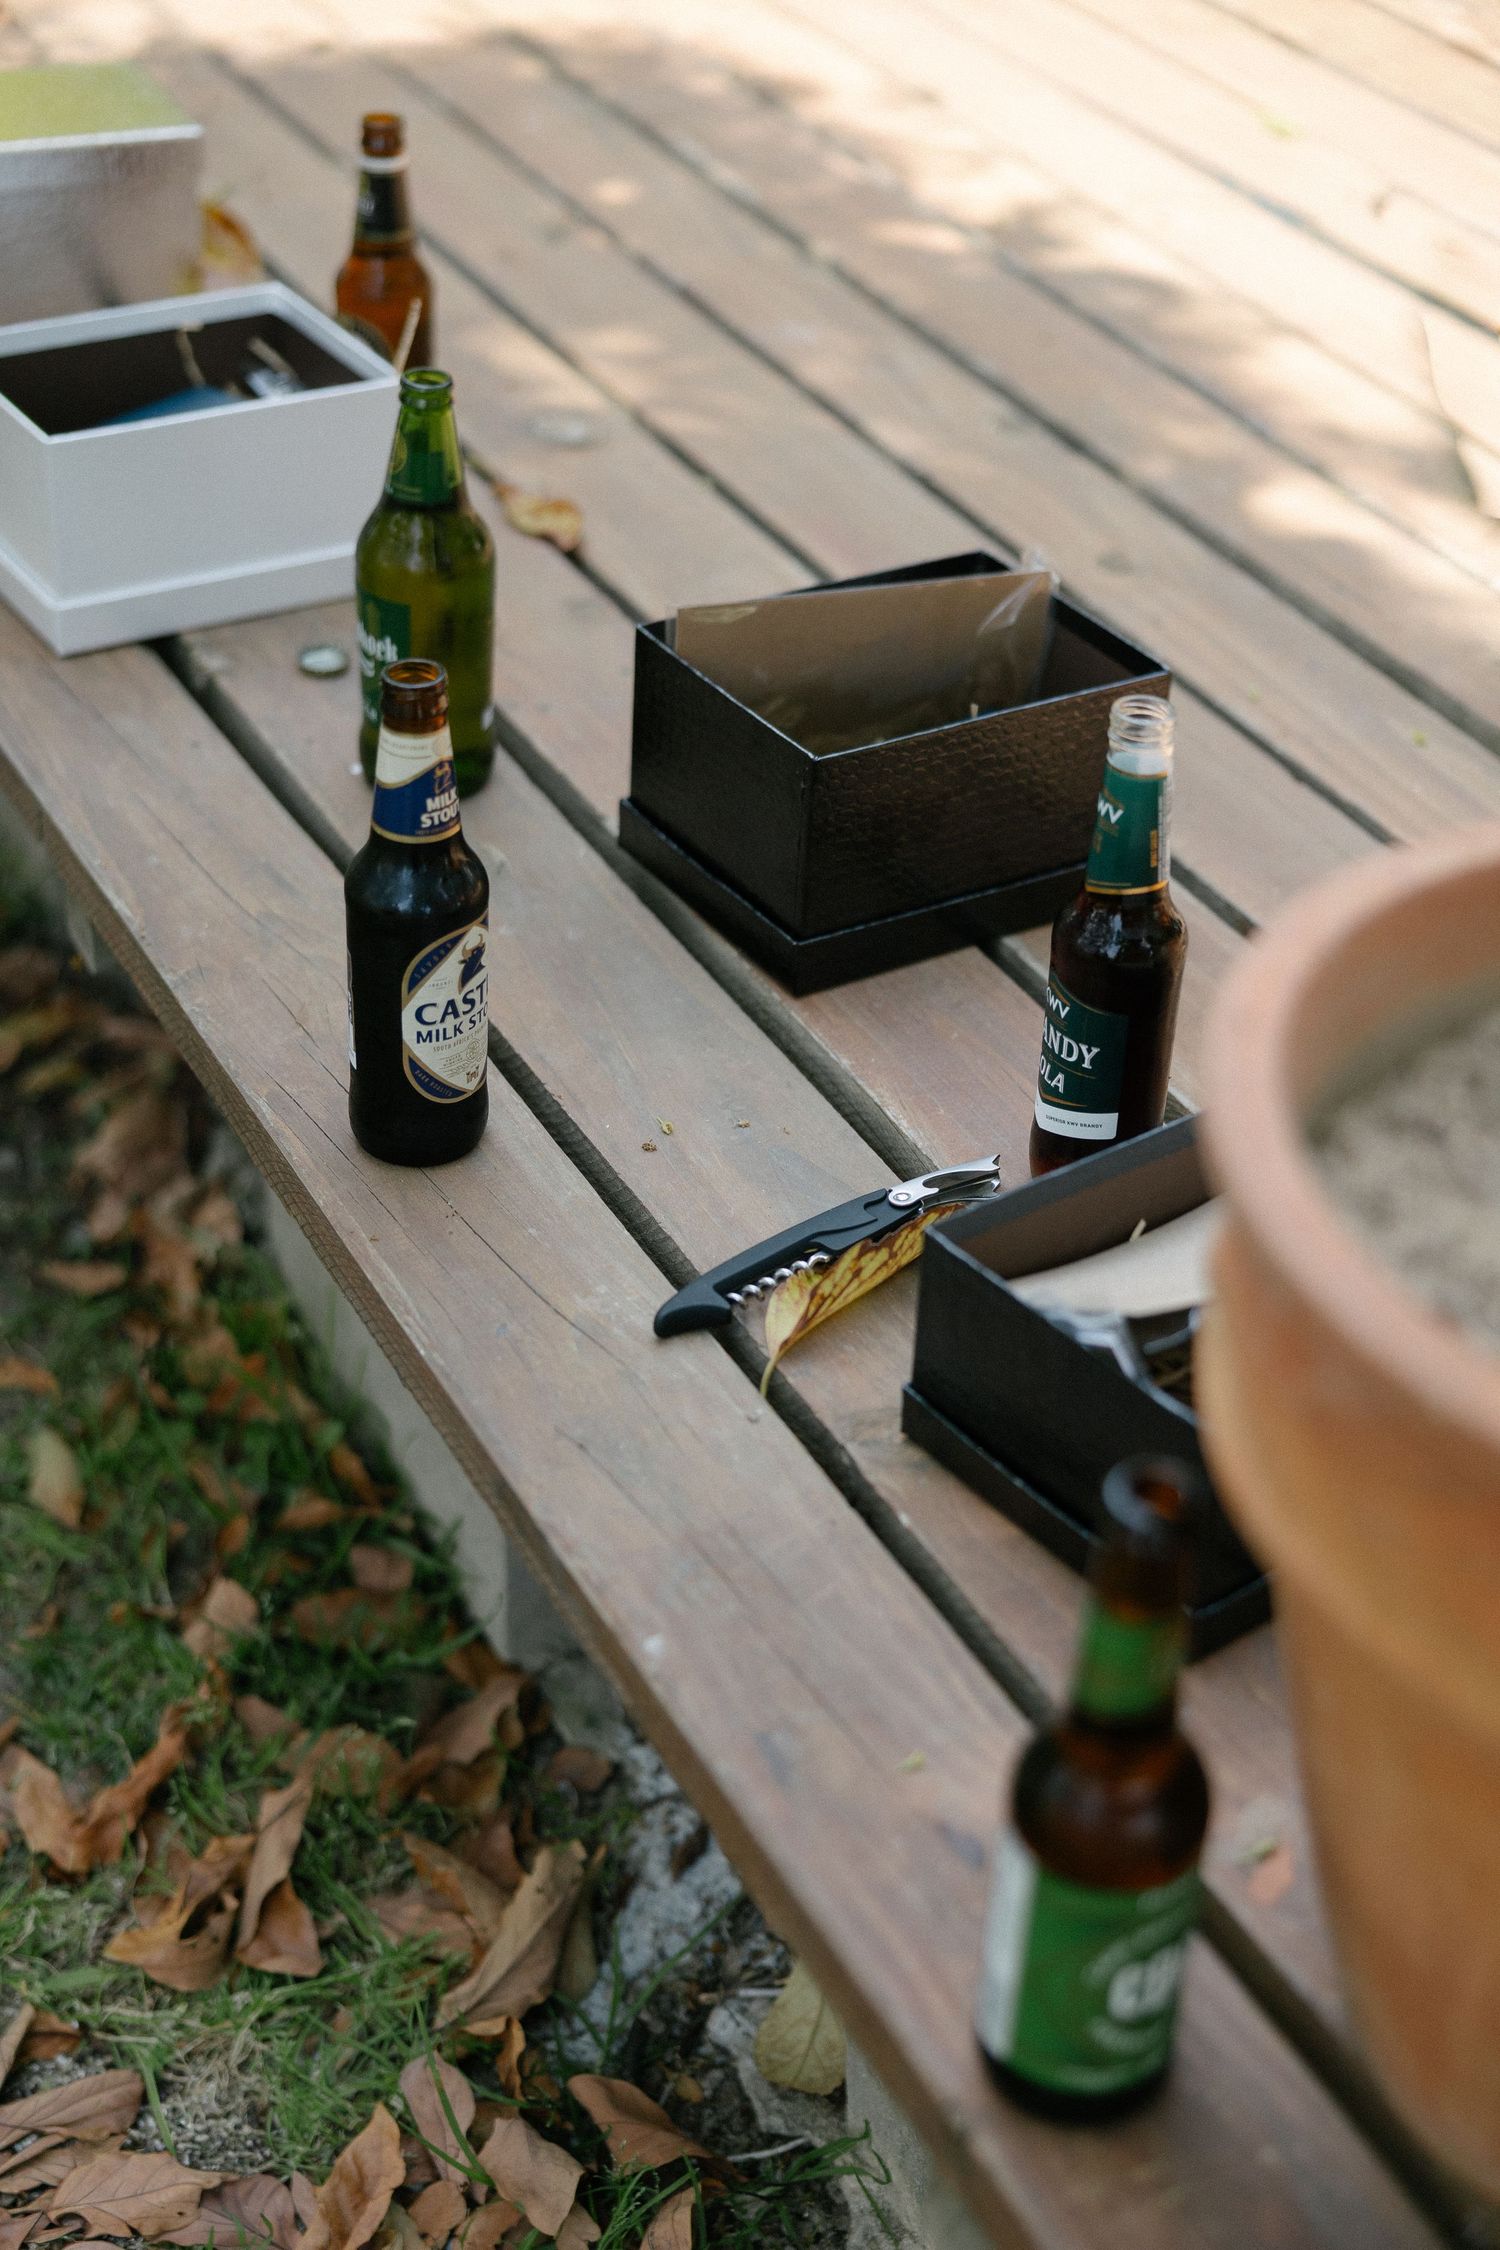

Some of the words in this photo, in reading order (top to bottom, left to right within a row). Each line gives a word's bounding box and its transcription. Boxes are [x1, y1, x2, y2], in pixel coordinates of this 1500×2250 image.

[425, 786, 458, 812] MILK
[414, 974, 489, 1026] CAST
[416, 1021, 464, 1044] MILK
[1045, 1114, 1066, 1125] SUPERIOR
